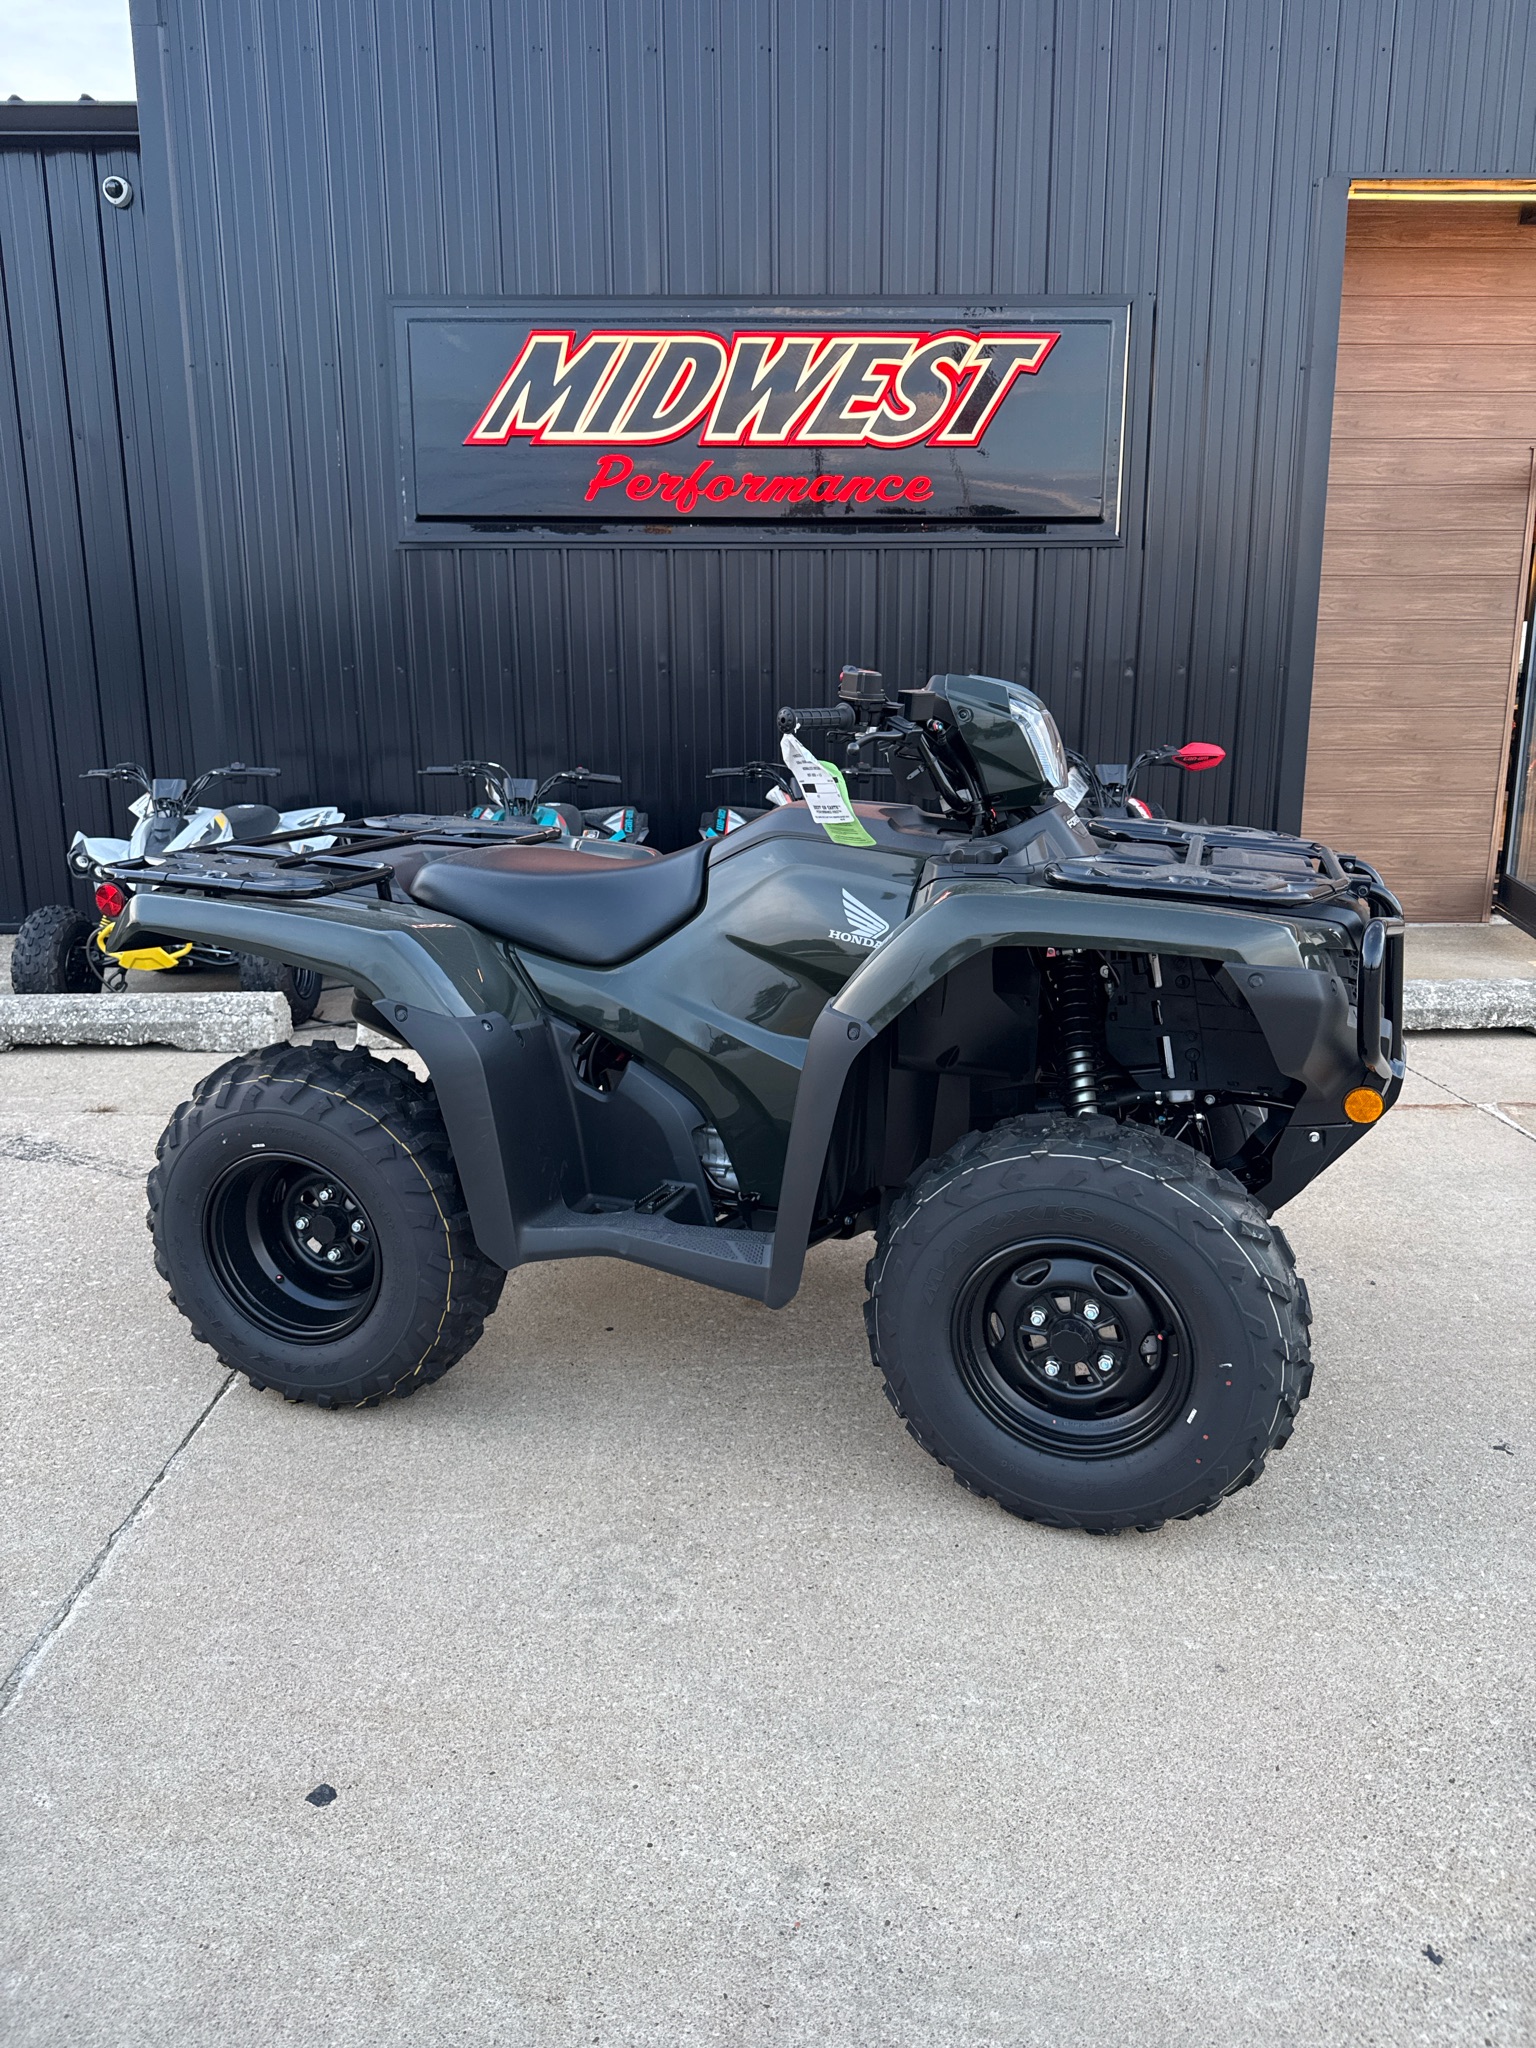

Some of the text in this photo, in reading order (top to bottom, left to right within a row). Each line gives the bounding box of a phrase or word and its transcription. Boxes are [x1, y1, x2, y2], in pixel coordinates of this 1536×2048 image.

[463, 329, 1061, 449] MIDWEST
[584, 453, 935, 513] Performance
[828, 929, 883, 949] HONDA
[921, 1204, 1097, 1304] MAXXIS
